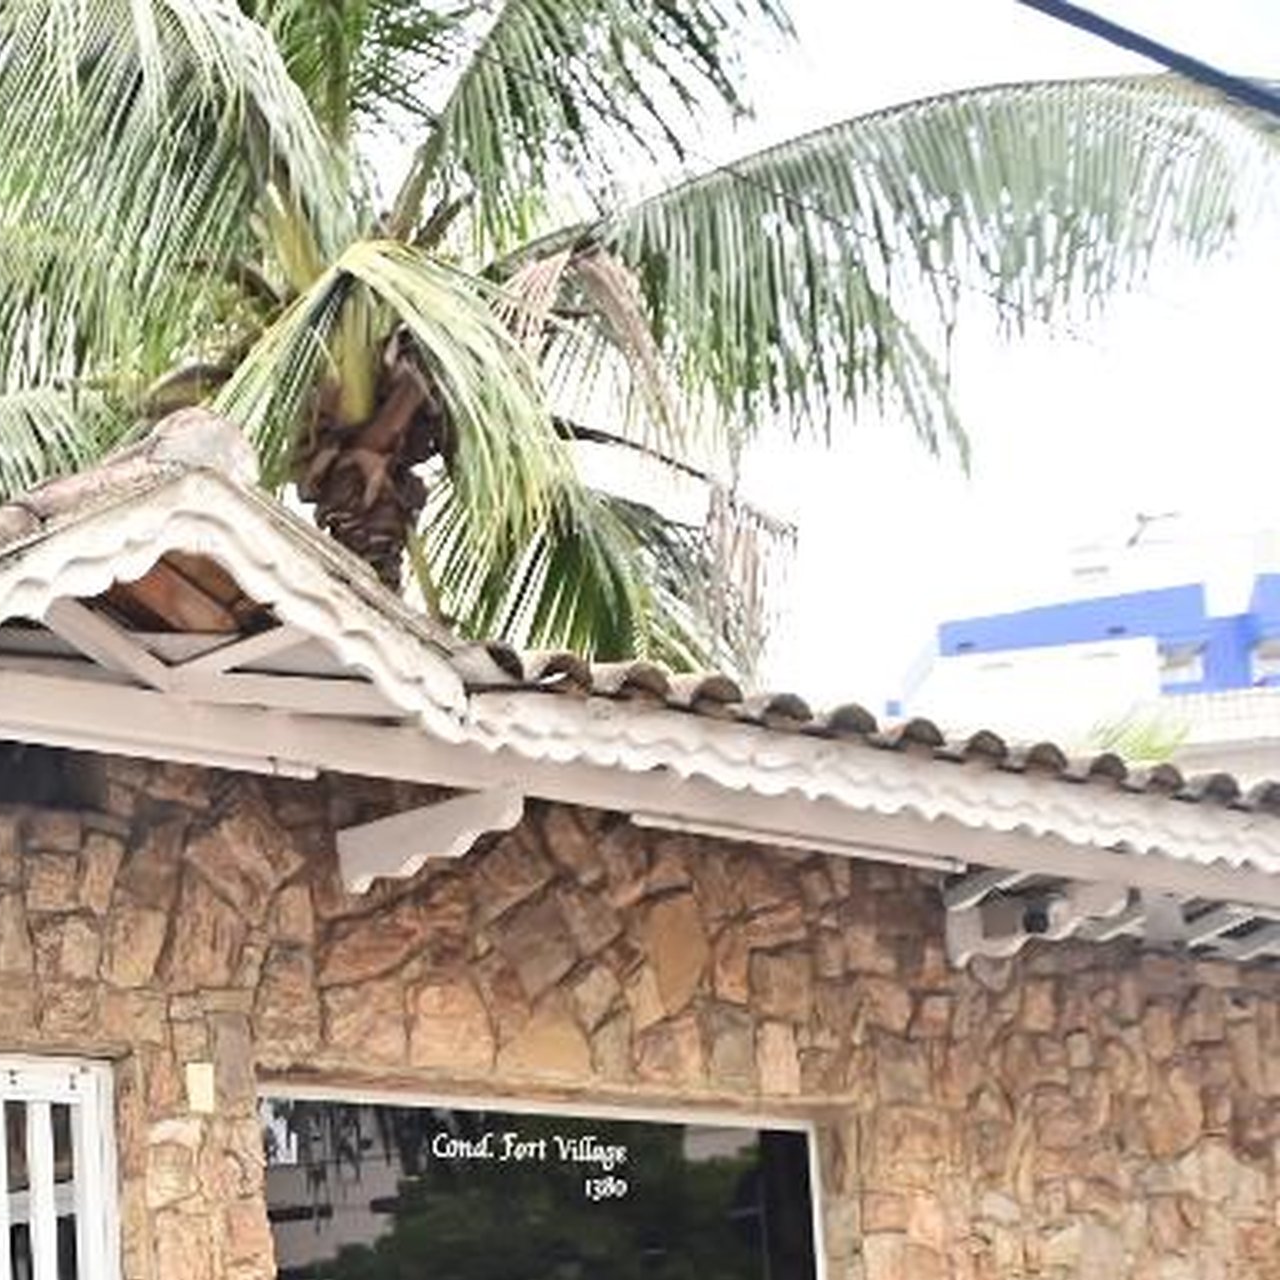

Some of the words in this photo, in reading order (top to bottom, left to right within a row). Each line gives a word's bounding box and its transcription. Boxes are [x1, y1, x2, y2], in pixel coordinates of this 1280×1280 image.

[499, 1132, 547, 1161] Fort
[553, 1135, 628, 1171] Village
[584, 1176, 629, 1201] 1380
